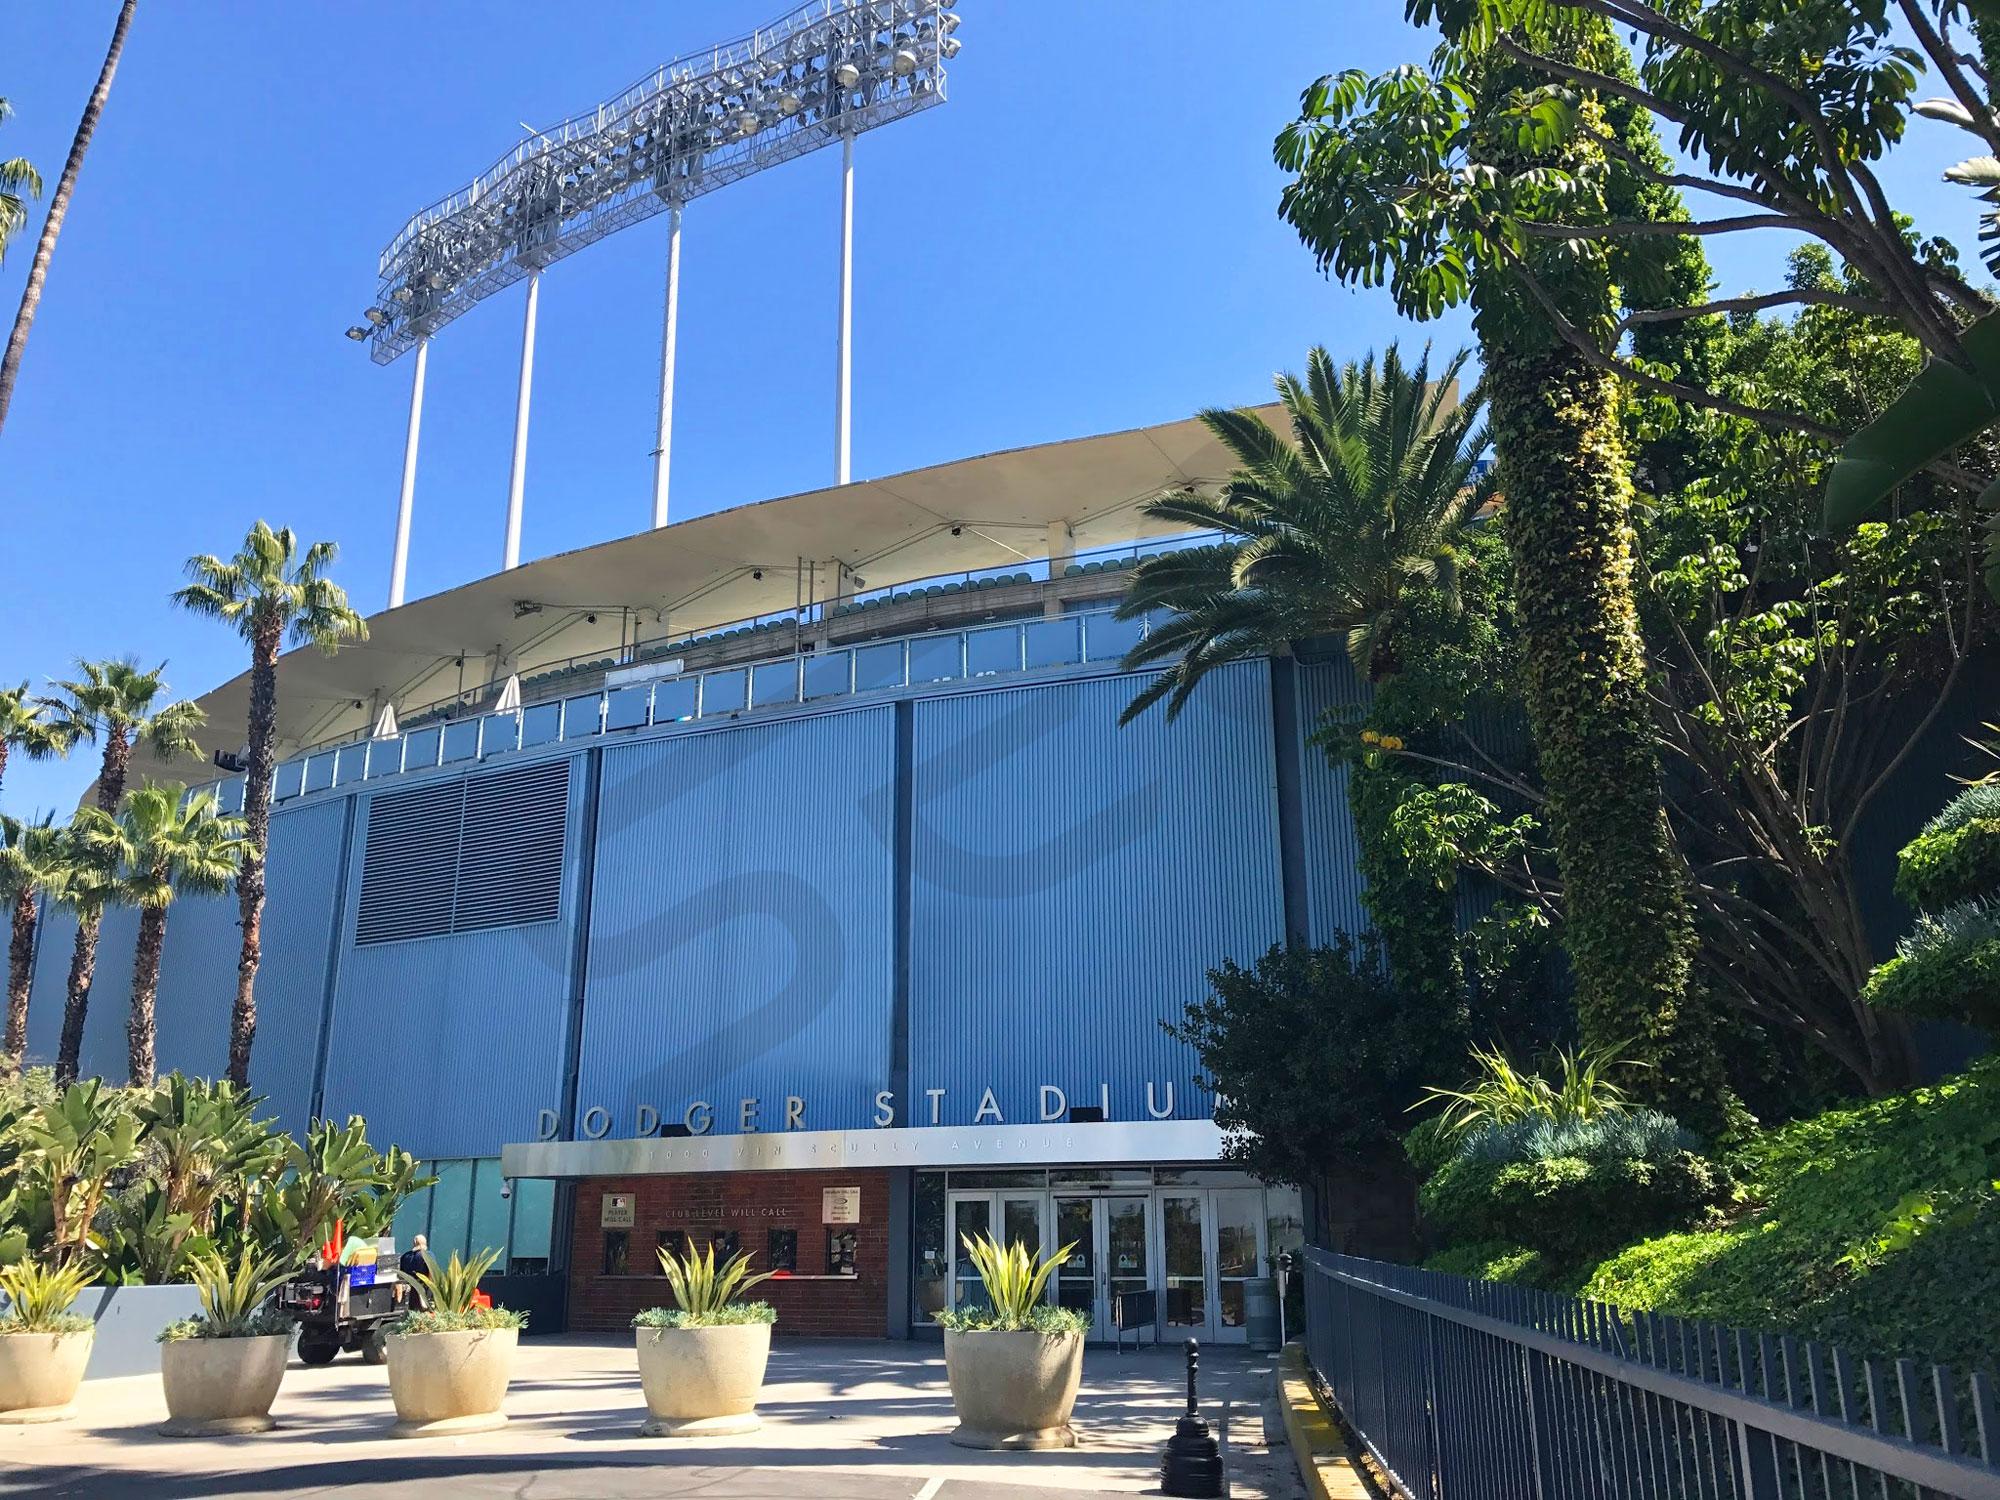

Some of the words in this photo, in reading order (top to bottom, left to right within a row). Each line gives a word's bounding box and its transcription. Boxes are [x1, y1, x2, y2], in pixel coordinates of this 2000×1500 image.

[540, 1096, 807, 1141] DODGER
[649, 1149, 710, 1160] 1000
[736, 1146, 782, 1159] VIN
[809, 1142, 920, 1154] SCULLY
[951, 1138, 1073, 1150] AVENUE
[665, 1208, 691, 1218] CLUB
[695, 1207, 726, 1217] LEVEL
[730, 1208, 756, 1217] WILL
[760, 1207, 787, 1216] CALL
